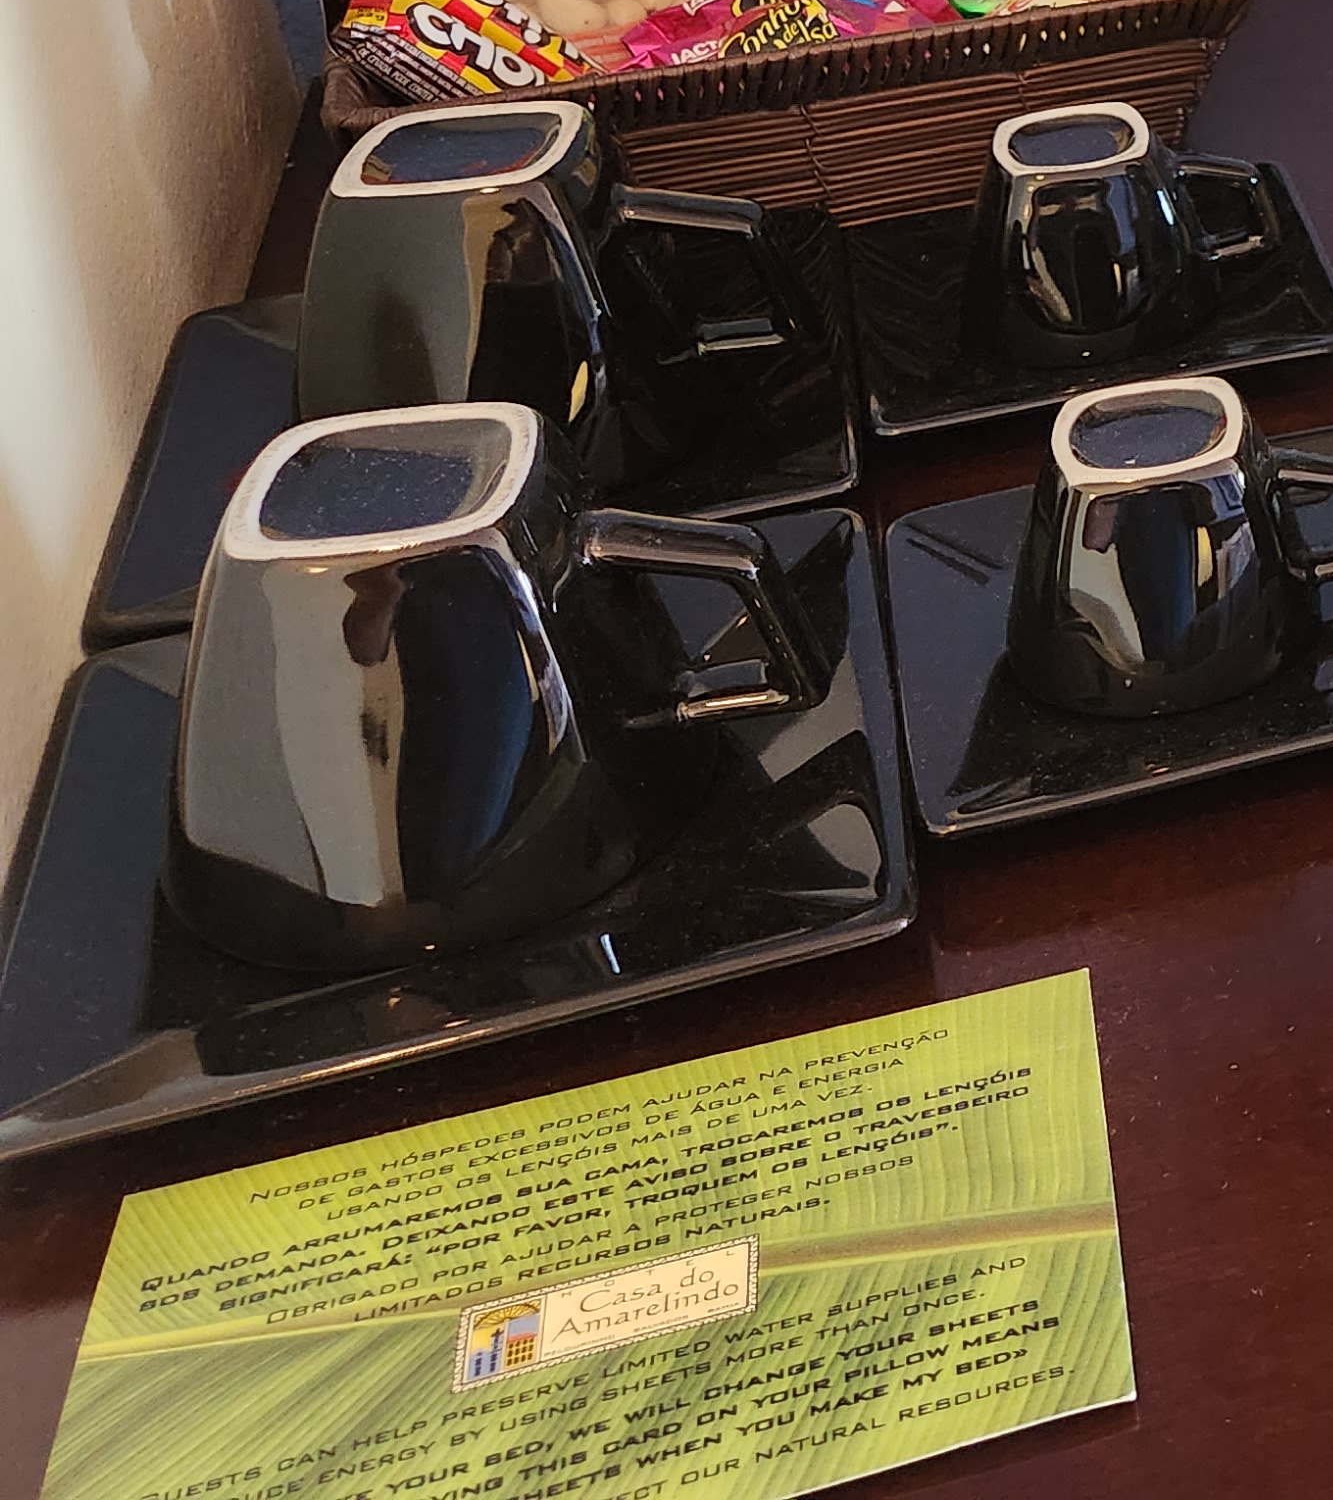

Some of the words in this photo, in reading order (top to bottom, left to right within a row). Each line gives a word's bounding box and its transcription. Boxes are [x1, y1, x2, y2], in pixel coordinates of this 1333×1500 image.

[250, 1167, 366, 1203] NOSSOS
[381, 1129, 525, 1171] HÓSPEDES
[539, 1103, 630, 1132] PODEM
[642, 1077, 745, 1108] AJUDAR
[759, 1067, 792, 1081] NA
[805, 1029, 948, 1070] PREVENÇÃO
[551, 1279, 739, 1343] Amarelindo
[579, 1283, 663, 1312] Casa
[675, 1266, 714, 1295] do
